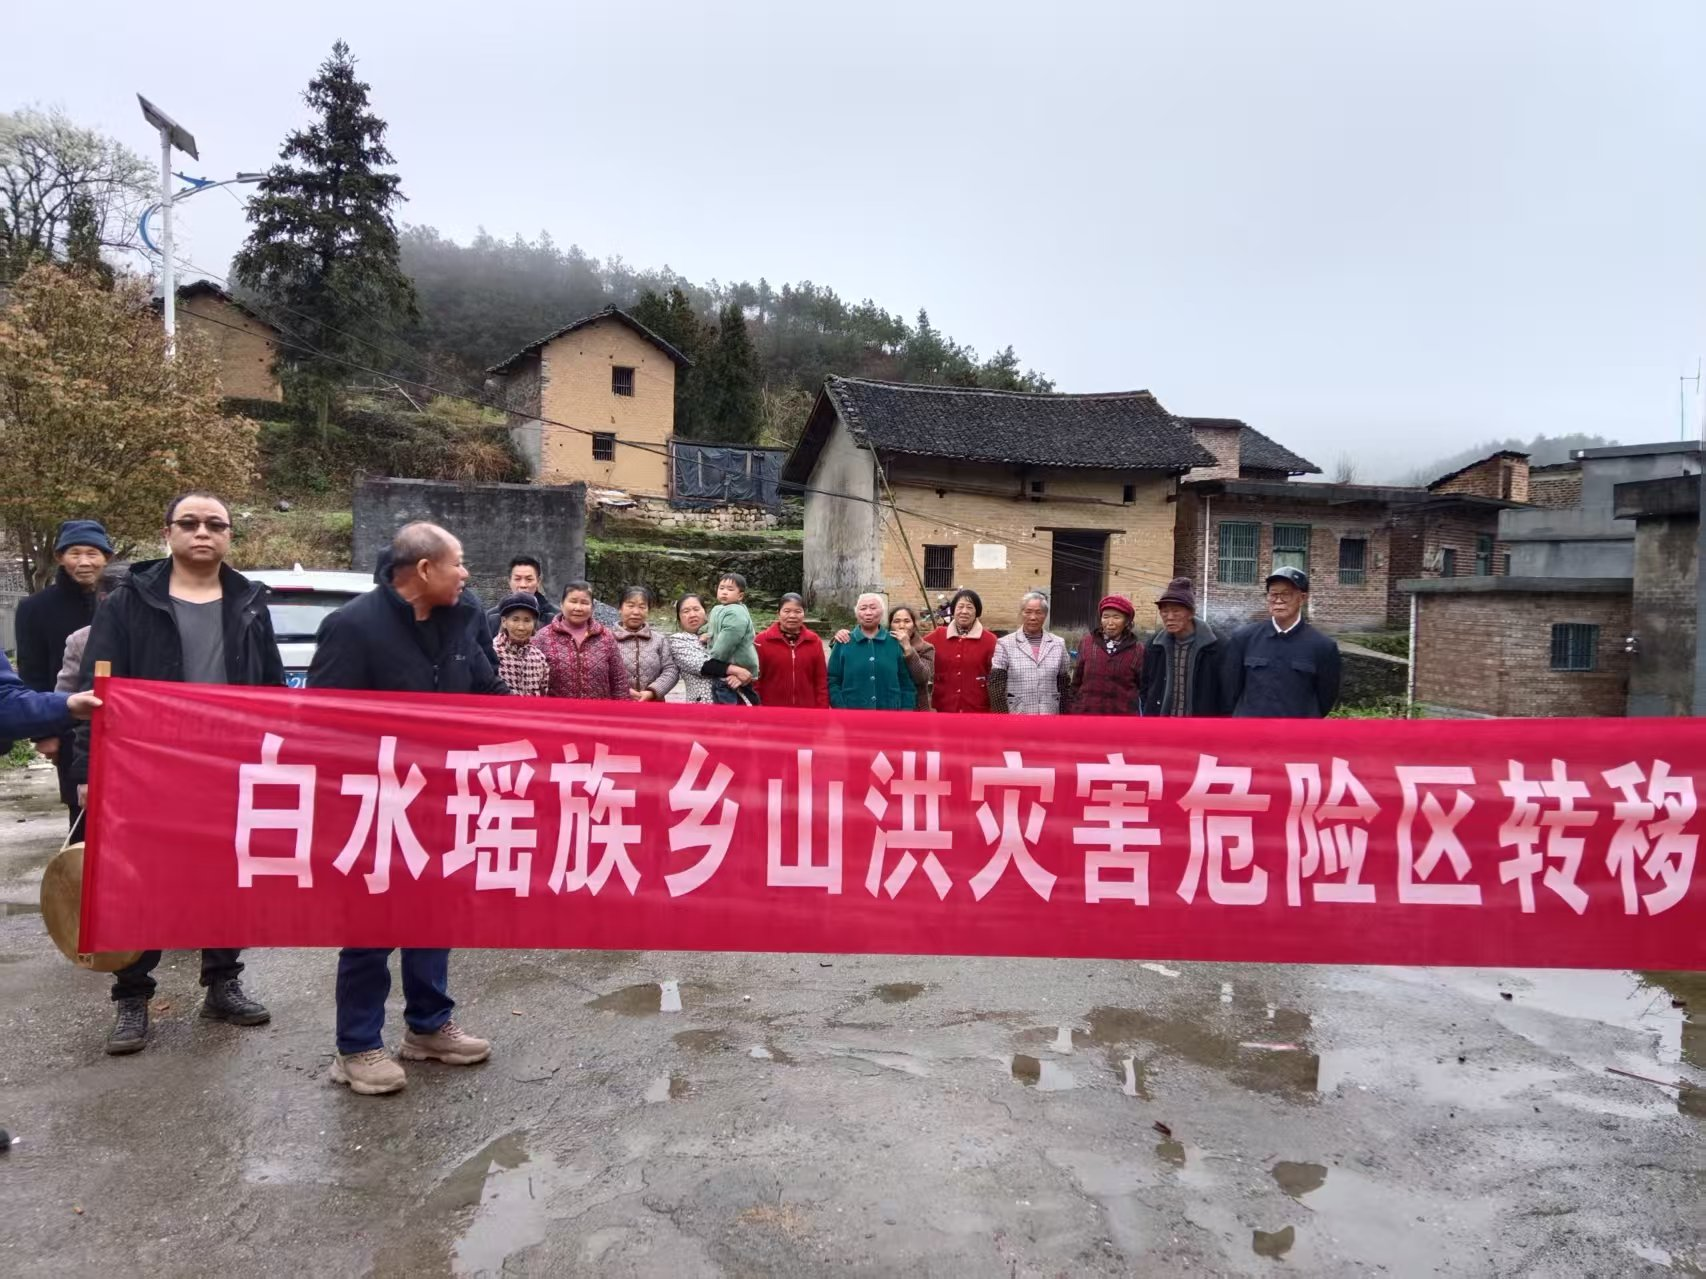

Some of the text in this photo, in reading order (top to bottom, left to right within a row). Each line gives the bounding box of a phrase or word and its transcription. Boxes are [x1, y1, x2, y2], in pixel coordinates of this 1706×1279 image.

[235, 733, 1698, 916] 白水瑶族乡山洪灾害危险区转移
